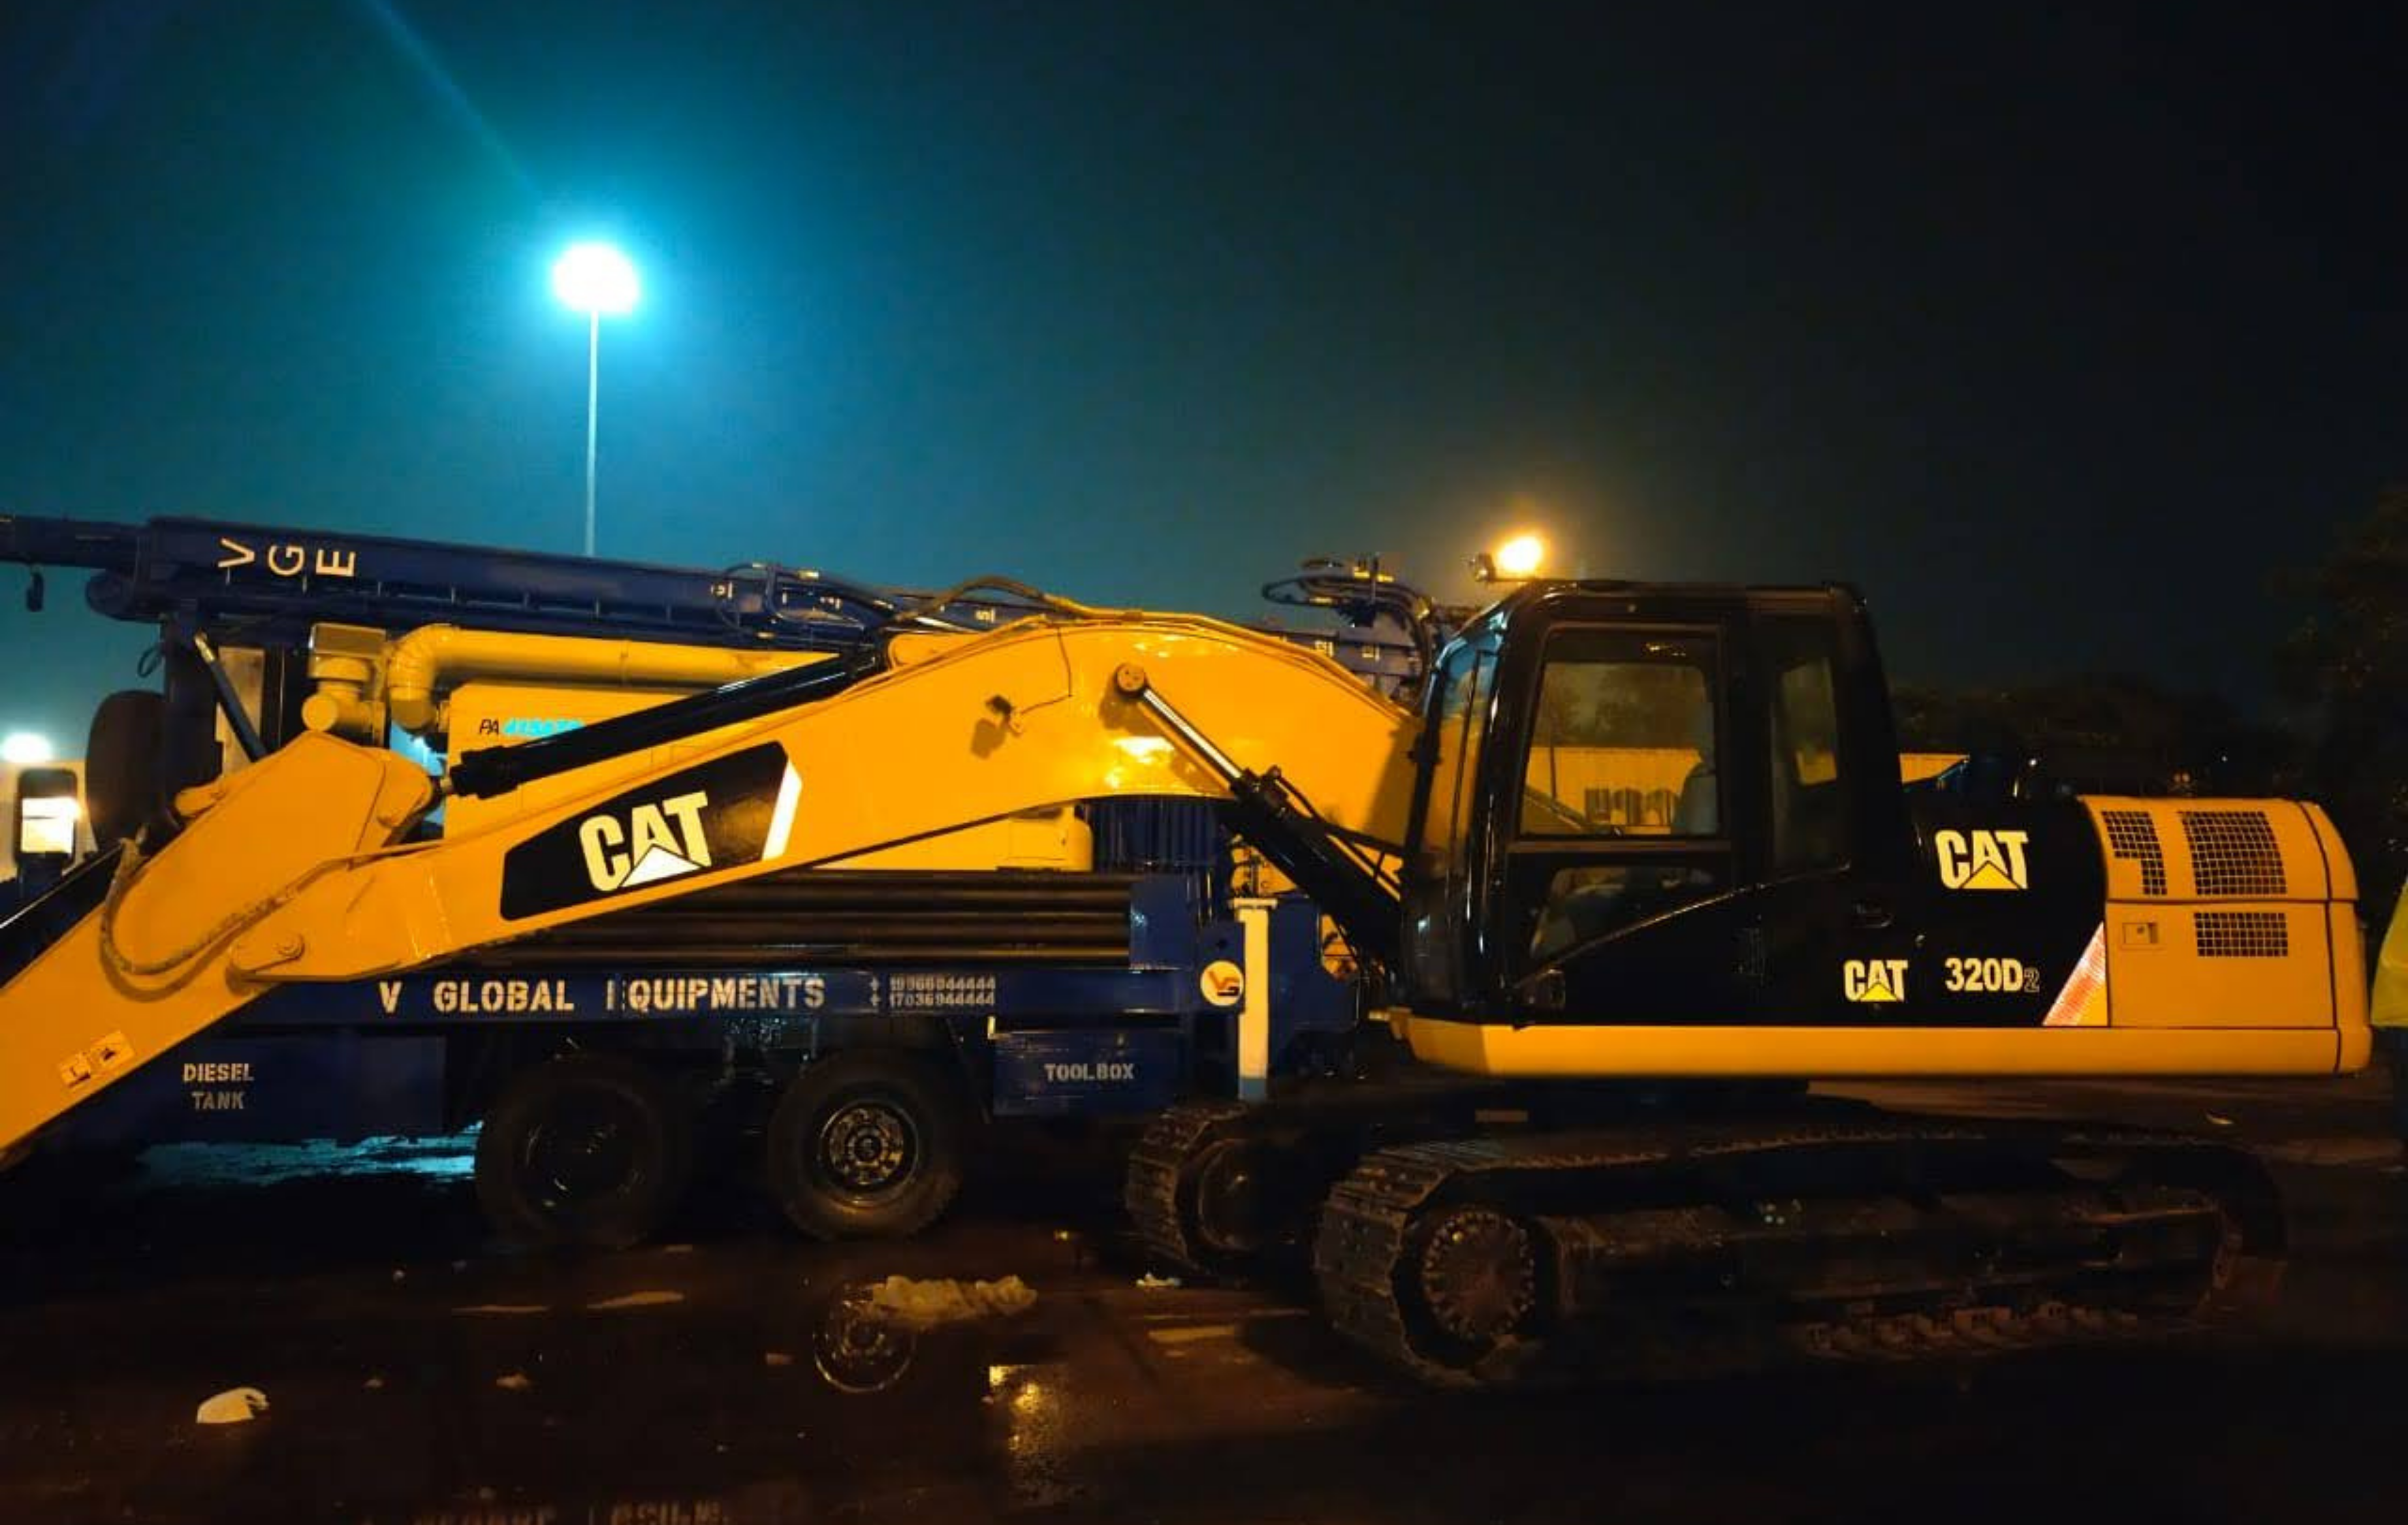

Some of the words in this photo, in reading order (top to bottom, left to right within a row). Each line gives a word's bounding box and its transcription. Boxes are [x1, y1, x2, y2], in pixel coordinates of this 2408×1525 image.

[579, 791, 712, 892] CAT
[1935, 829, 2028, 889] CAT
[379, 981, 402, 1013] V
[433, 979, 575, 1013] GLOBAL
[1843, 960, 1908, 1002] CAT
[184, 1063, 255, 1082] DIESEL
[191, 1091, 245, 1111] TANK
